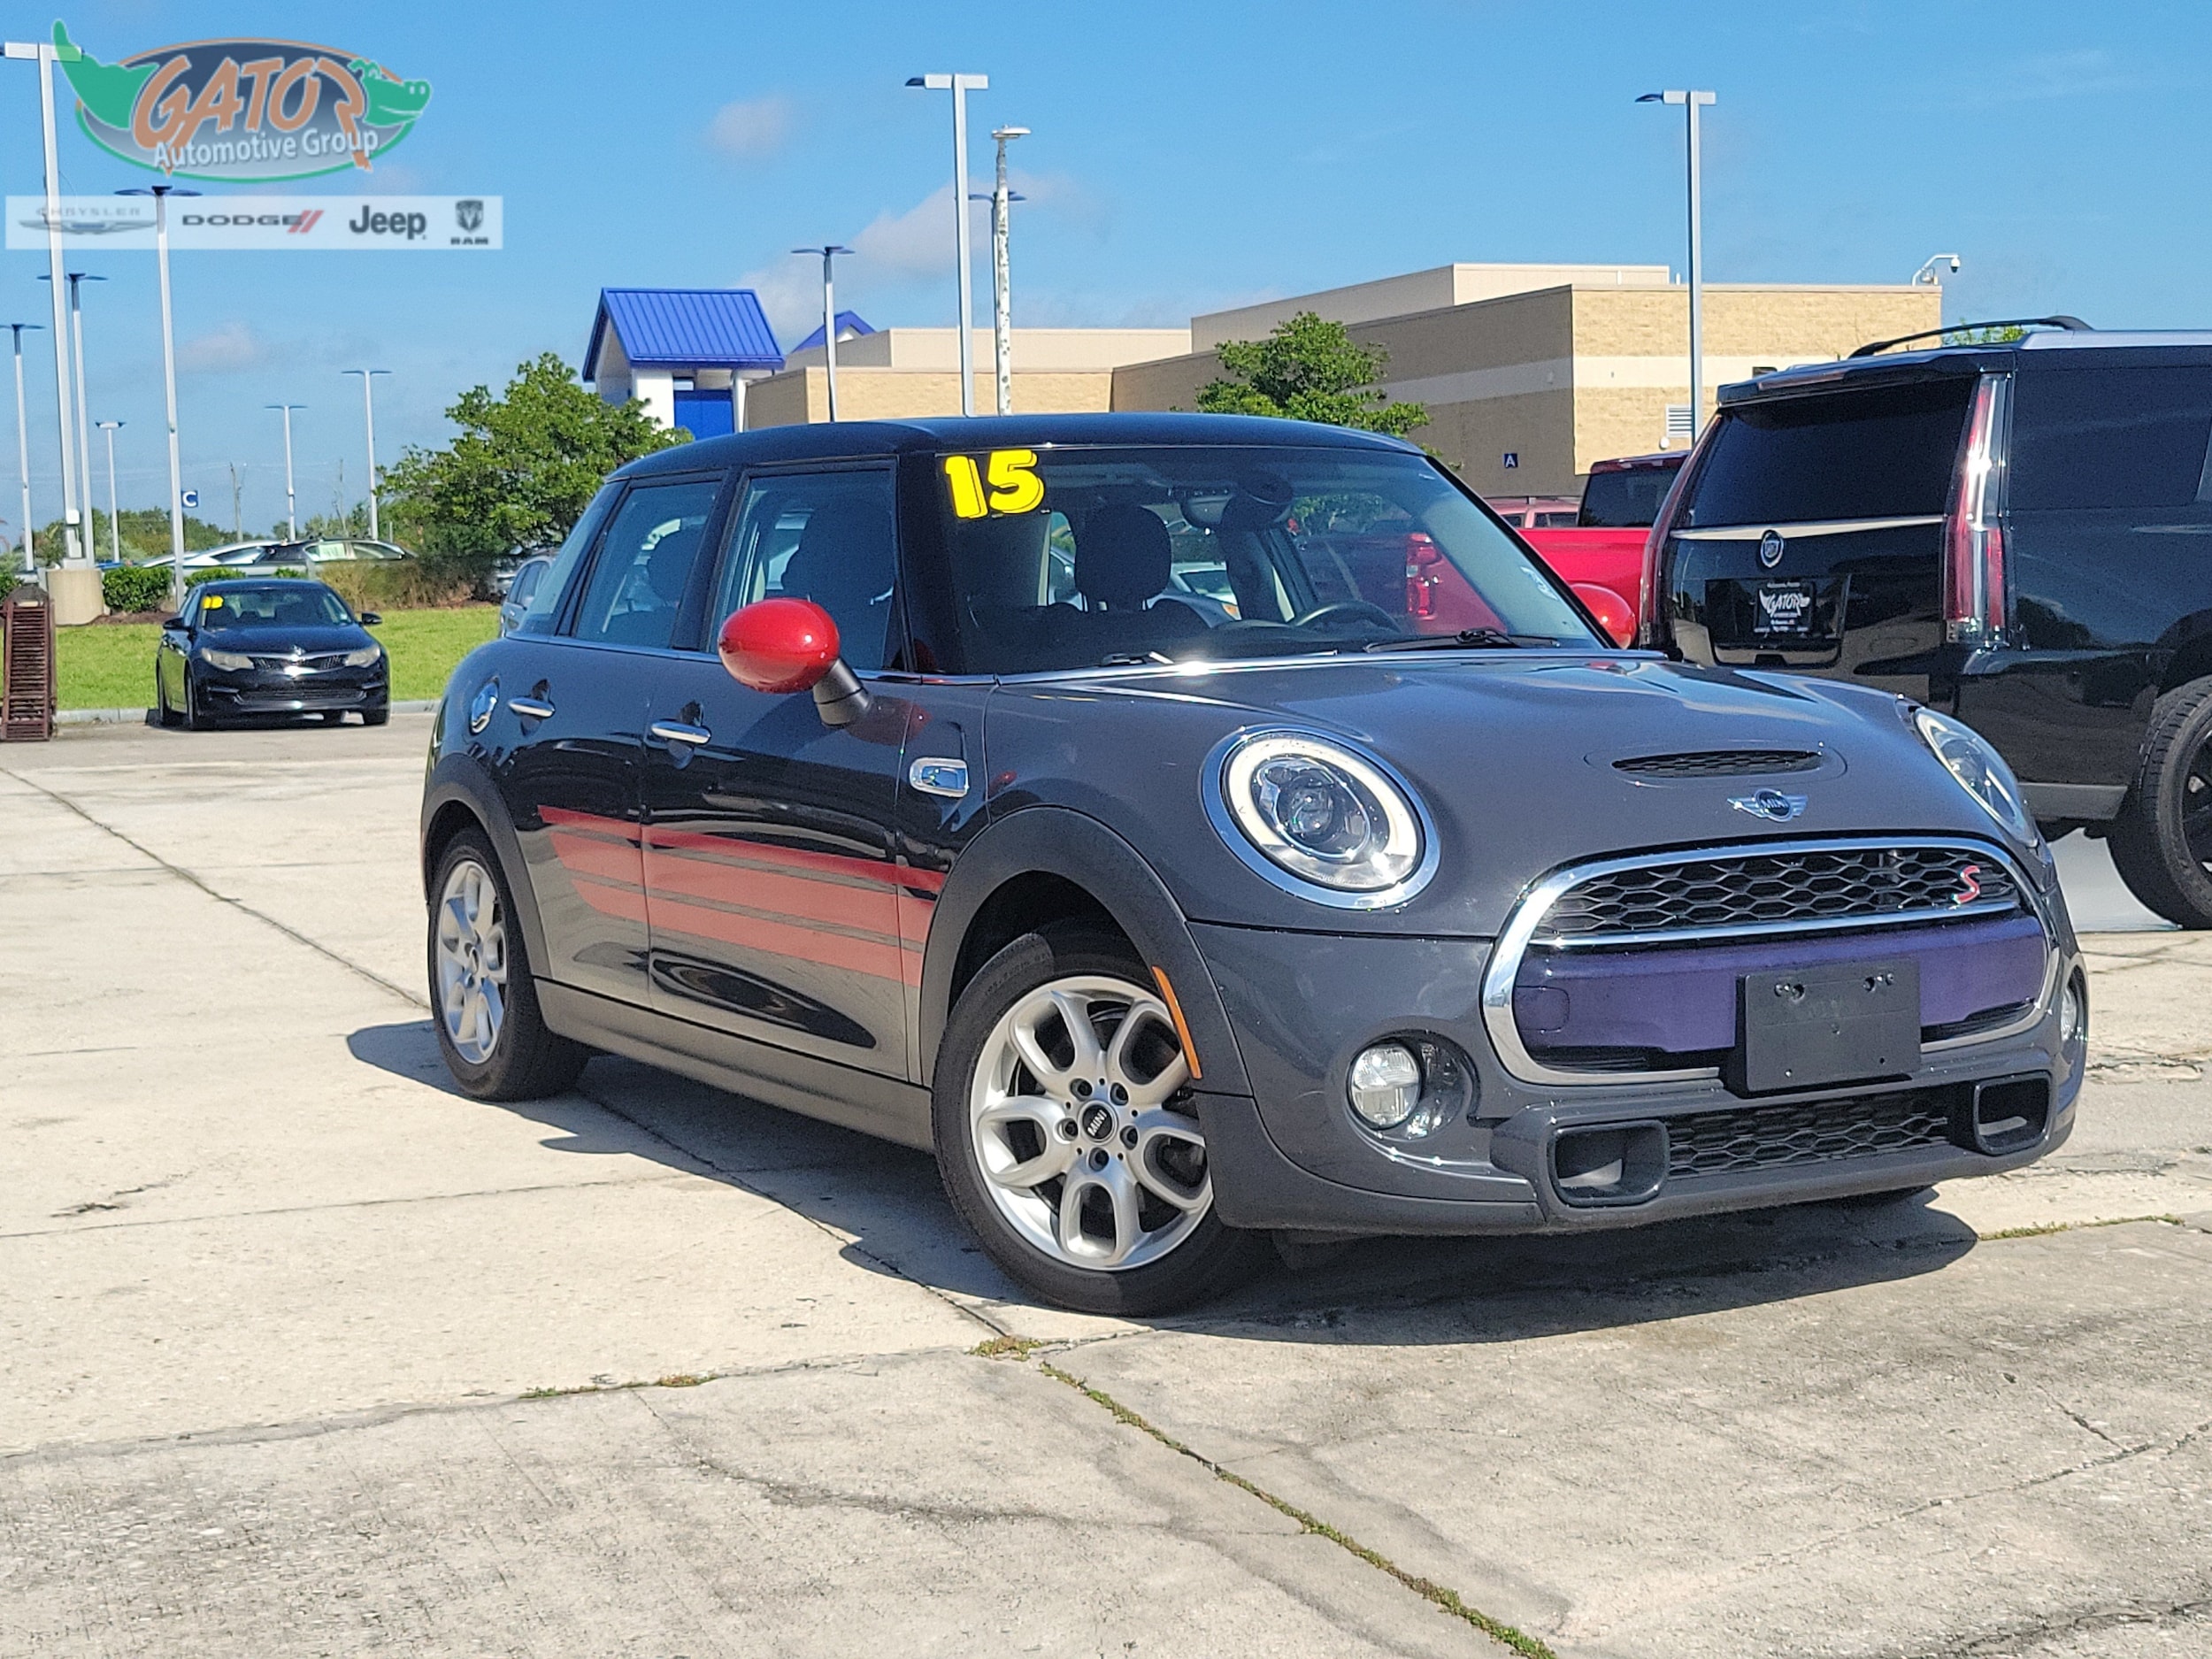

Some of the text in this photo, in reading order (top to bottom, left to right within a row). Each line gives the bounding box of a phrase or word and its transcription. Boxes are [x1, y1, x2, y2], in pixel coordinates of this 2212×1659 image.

[1505, 454, 1516, 468] A
[944, 449, 1045, 518] 15
[182, 491, 197, 507] C
[1766, 593, 1801, 618] GATOR
[1951, 864, 1981, 905] S
[1087, 1110, 1107, 1137] MINI
